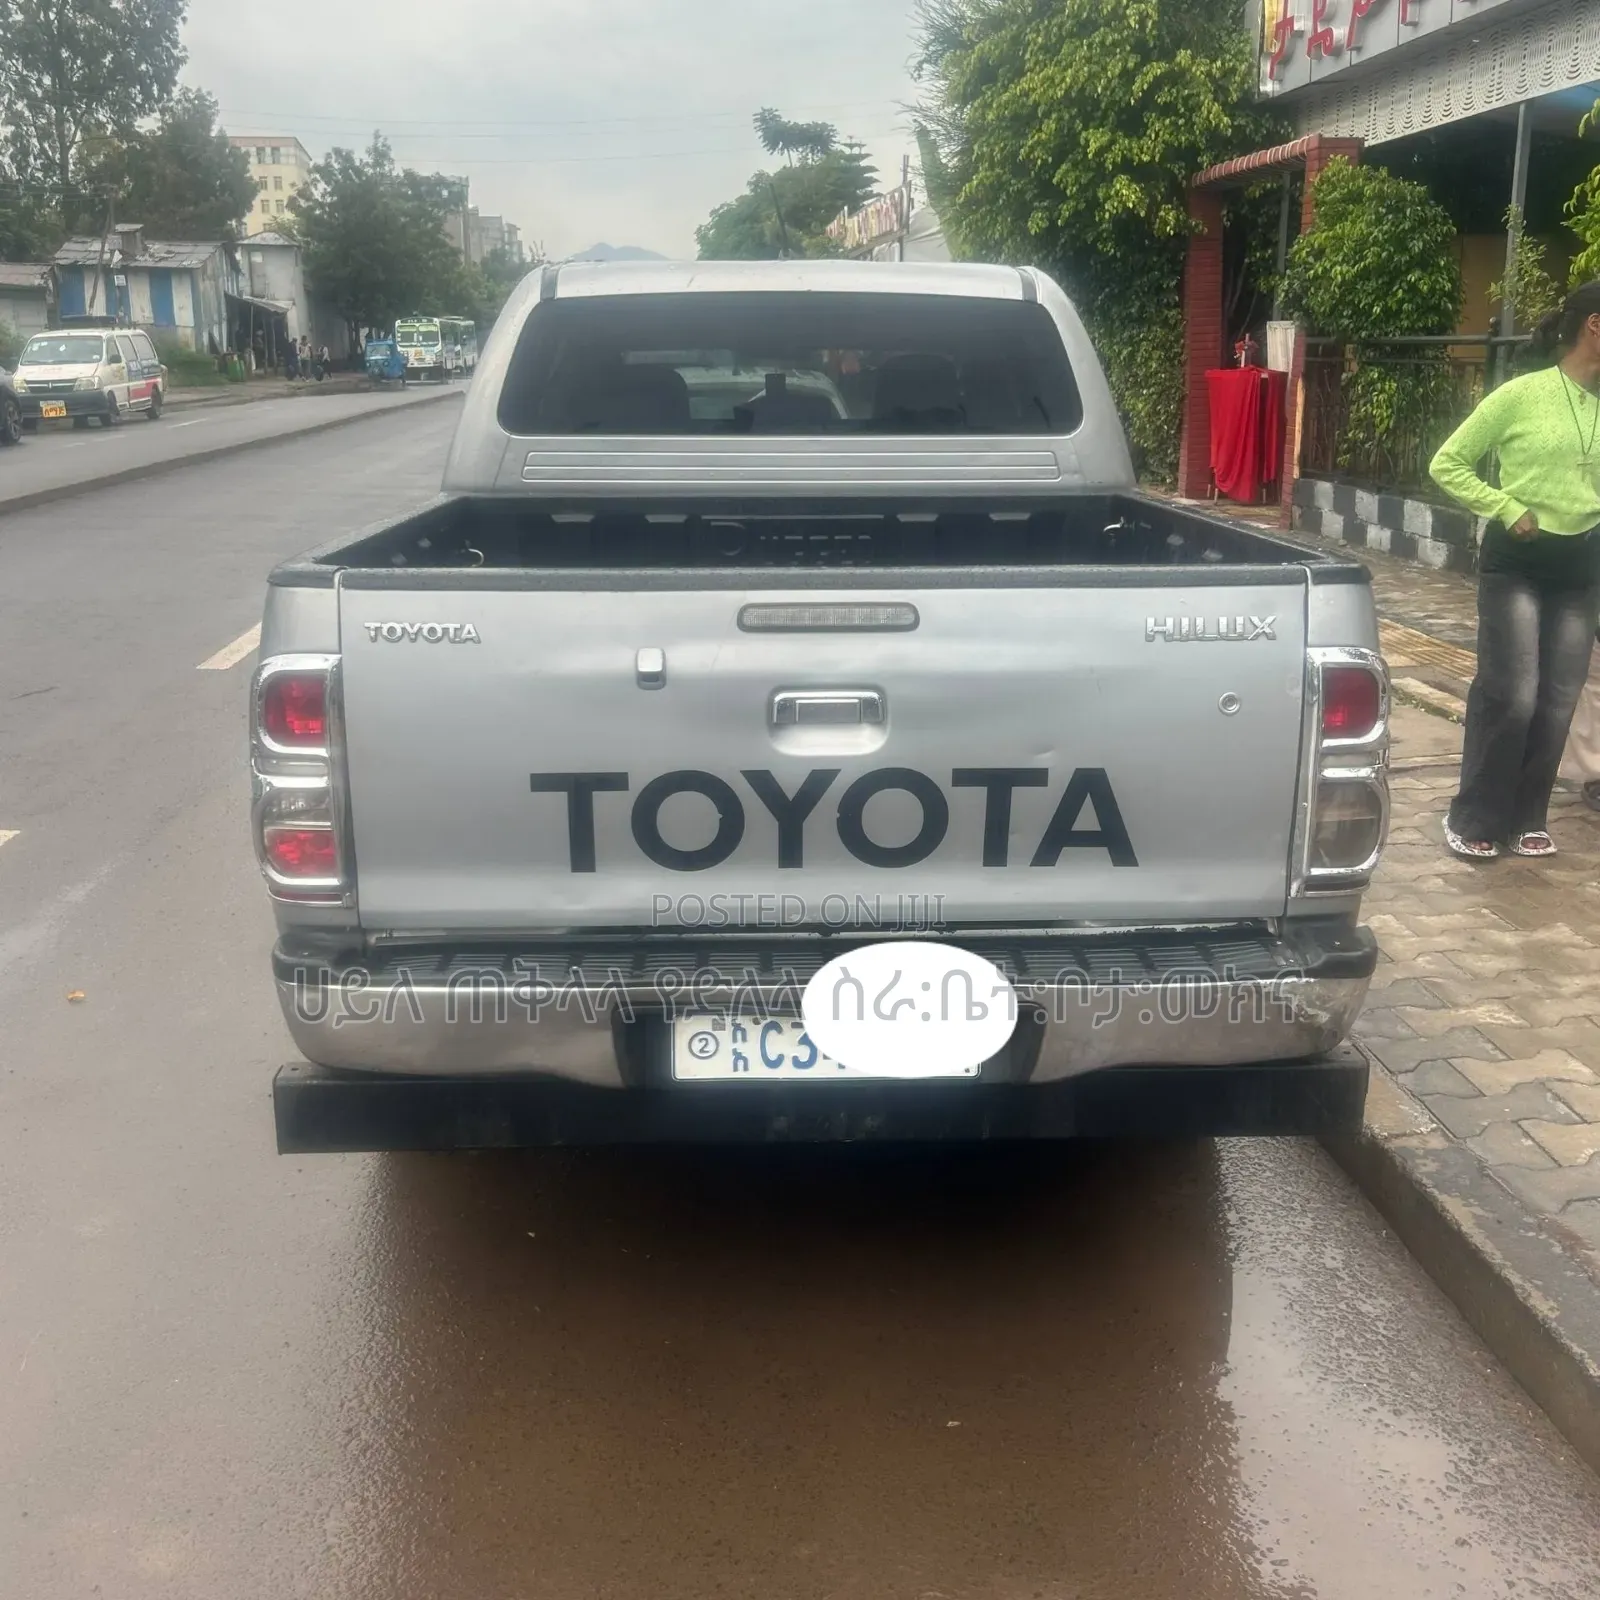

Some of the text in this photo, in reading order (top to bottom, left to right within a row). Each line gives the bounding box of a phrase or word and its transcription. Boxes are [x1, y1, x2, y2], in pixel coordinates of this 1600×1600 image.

[364, 622, 481, 644] TOYOTA
[1145, 615, 1277, 642] HILUX
[529, 767, 1139, 873] TOYOTA
[759, 1020, 846, 1070] C3
